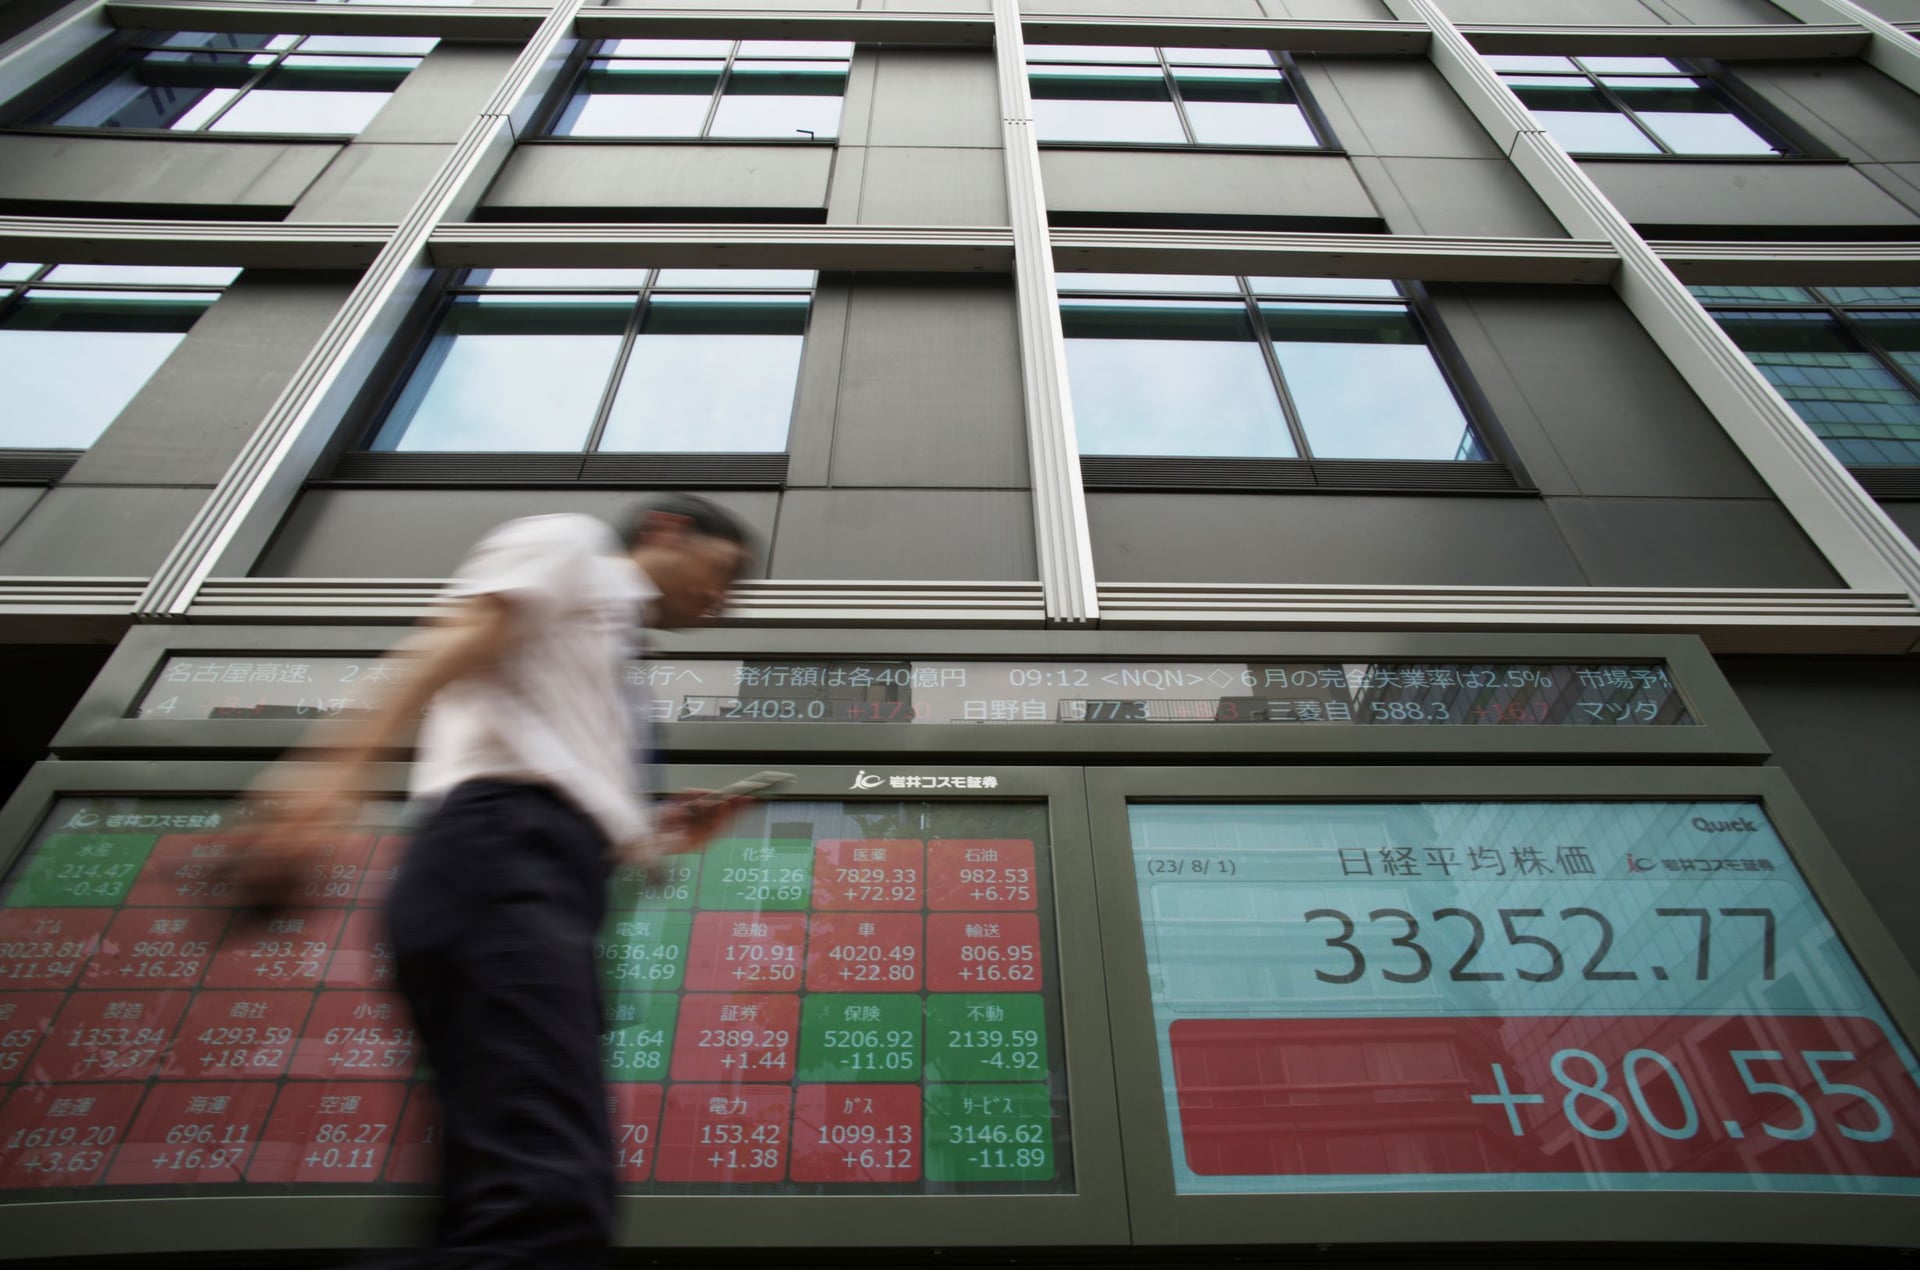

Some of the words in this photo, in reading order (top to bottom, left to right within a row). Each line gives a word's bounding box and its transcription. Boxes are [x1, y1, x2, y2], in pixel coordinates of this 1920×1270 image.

[165, 662, 314, 684] 名古屋高速、
[732, 666, 966, 689] 発行額は各40億円
[1008, 668, 1089, 688] 09:12
[640, 699, 706, 720] ヨタ
[725, 699, 825, 720] 2403.0
[963, 700, 1048, 721] 日野自
[1071, 701, 1150, 721] 577.3
[1267, 701, 1352, 722] 三菱自
[1371, 702, 1450, 722] 588.3
[1472, 702, 1550, 722] +16.7
[1576, 701, 1658, 722] マツダ
[889, 775, 998, 789] 岩井コスモ証券
[105, 812, 222, 828] 岩井コスモ証券
[741, 847, 777, 863] 化学
[854, 848, 888, 863] 医薬
[964, 848, 999, 863] 石油
[1338, 845, 1597, 878] 日経平均株価
[57, 863, 135, 879] 214.47
[1661, 857, 1775, 873] 岩井コスモ証券
[721, 868, 804, 884] 2051.26
[836, 868, 917, 884] 7829.33
[959, 868, 1029, 884] 982.53
[65, 881, 123, 896] -0.43
[736, 886, 803, 901] -20.69
[843, 886, 917, 901] +72.92
[970, 886, 1030, 901] +6.75
[732, 922, 768, 937] 造船
[858, 922, 875, 937] 車
[964, 922, 1001, 938] 輸送
[131, 941, 210, 958] 960.05
[250, 941, 327, 958] 293.79
[725, 944, 795, 961] 170.91
[829, 944, 915, 961] 4020.49
[960, 944, 1033, 961] 806.95
[1303, 907, 1776, 985] 33252.77
[119, 961, 200, 977] +16.28
[255, 960, 319, 977] +5.72
[606, 963, 676, 980] -54.69
[731, 964, 795, 981] +2.50
[838, 964, 915, 981] +22.80
[958, 964, 1034, 981] +16.62
[228, 1002, 269, 1020] 商社
[352, 1003, 393, 1020] 小売
[720, 1005, 758, 1022] 証券
[844, 1005, 881, 1022] 保険
[966, 1005, 1004, 1022] 不動
[67, 1027, 166, 1046] 1353.84
[197, 1028, 293, 1046] 4293.59
[324, 1028, 415, 1046] 6745.31
[698, 1030, 789, 1048] 2389.29
[823, 1030, 913, 1048] 5206.92
[948, 1030, 1038, 1048] 2139.59
[82, 1049, 157, 1068] +3.37
[198, 1049, 284, 1067] +18.62
[327, 1049, 412, 1067] +22.57
[720, 1052, 787, 1069] +1.44
[840, 1052, 913, 1069] -11.05
[980, 1052, 1040, 1069] -4.92
[1471, 1047, 1895, 1141] +80.55
[46, 1098, 96, 1116] 陸運
[183, 1095, 231, 1114] 海運
[317, 1095, 362, 1114] 空運
[708, 1097, 748, 1116] 電力
[7, 1126, 116, 1149] 1619.20
[165, 1124, 247, 1144] 696.11
[315, 1123, 387, 1144] 86.27
[700, 1125, 780, 1144] 153.42
[817, 1125, 912, 1144] 1099.13
[949, 1125, 1044, 1144] 3146.62
[23, 1152, 100, 1172] +3.63
[151, 1148, 245, 1169] +16.97
[304, 1148, 376, 1168] +0.11
[707, 1148, 779, 1168] +1.38
[841, 1148, 913, 1169] +6.12
[968, 1148, 1045, 1168] -11.89
